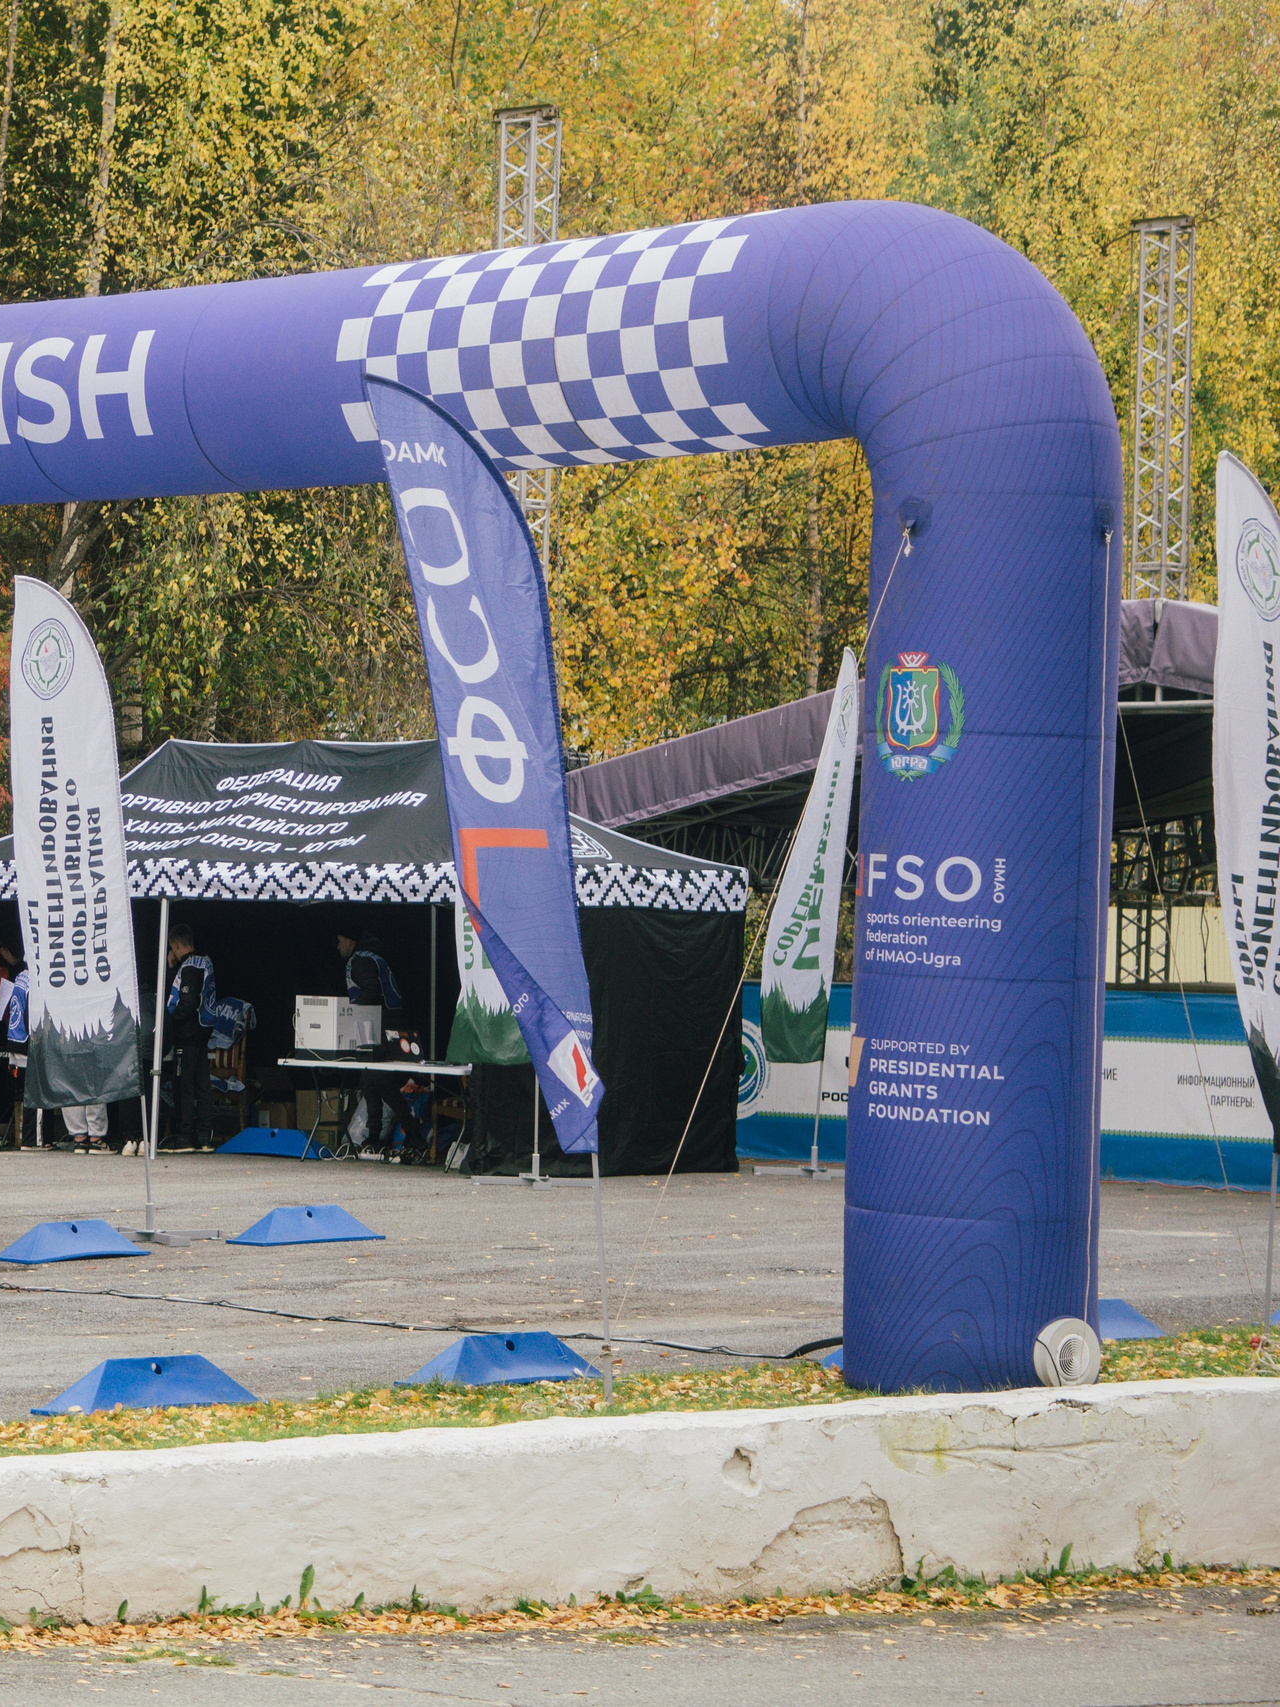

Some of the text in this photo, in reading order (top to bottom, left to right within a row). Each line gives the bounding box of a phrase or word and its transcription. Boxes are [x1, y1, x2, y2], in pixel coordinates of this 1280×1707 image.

[216, 768, 343, 793] ФЕДЕРАЦИЯ
[120, 792, 428, 816] ОРТИВНОГО ОРИЕНТИРОВАНИЯ
[123, 814, 349, 836] ХАНТЫ-МАНСИЙСКОГО
[124, 835, 201, 851] ОМНОГО
[199, 832, 283, 854] ОКРУГА
[299, 834, 367, 854] ЮГРЫ
[867, 853, 982, 902] FSO
[992, 857, 1007, 904] HMAO
[866, 912, 1002, 933] sports orienteering
[866, 929, 928, 946] federation
[865, 948, 962, 969] of HMAO-Ugra
[870, 1038, 971, 1056] SUPPORTED BY
[870, 1057, 1005, 1080] PRESIDENTIAL
[869, 1080, 938, 1100] GRANTS
[1177, 1074, 1256, 1089] ИНФОРМАЦИОННЫЙ
[1210, 1095, 1255, 1108] ПАРТНЕРЫ:
[868, 1103, 990, 1126] FOUNDATION
